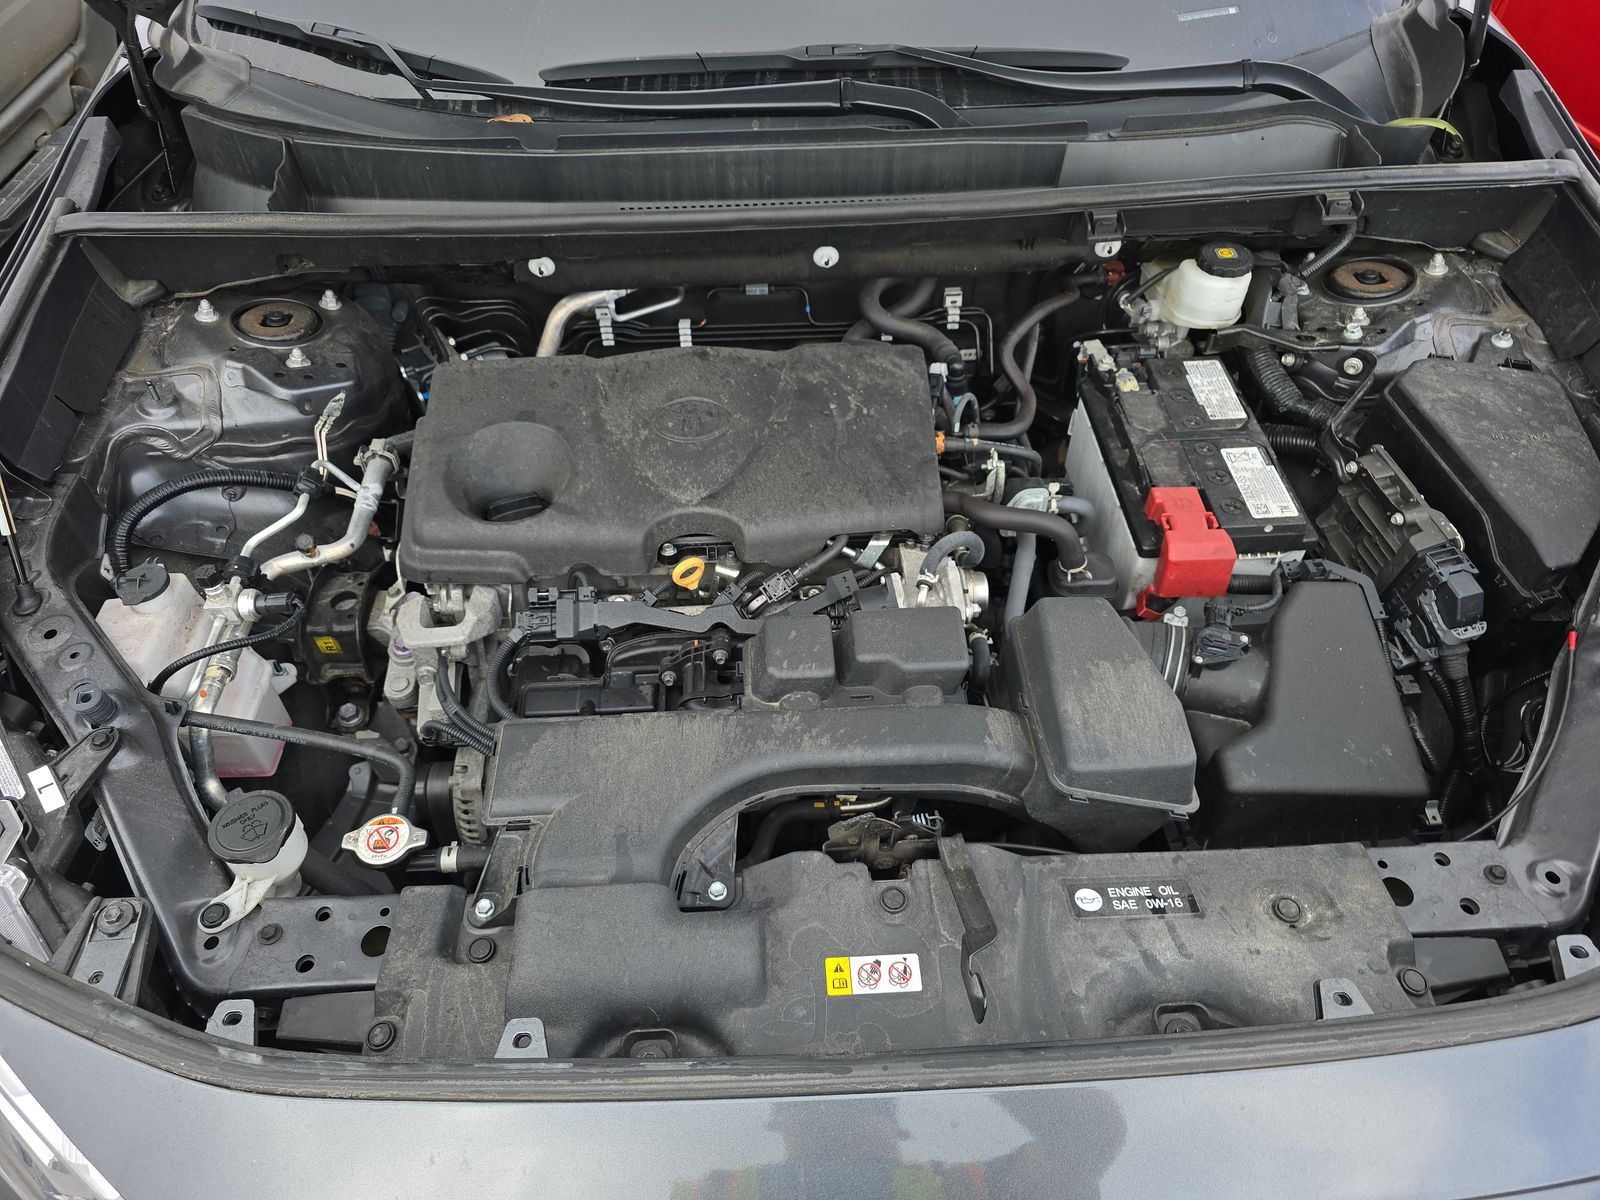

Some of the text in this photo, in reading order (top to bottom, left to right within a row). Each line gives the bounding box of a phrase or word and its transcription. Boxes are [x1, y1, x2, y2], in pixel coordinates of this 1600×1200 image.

[1107, 885, 1180, 897] ENGINE OIL
[1112, 898, 1184, 911] SAE 0W-16
